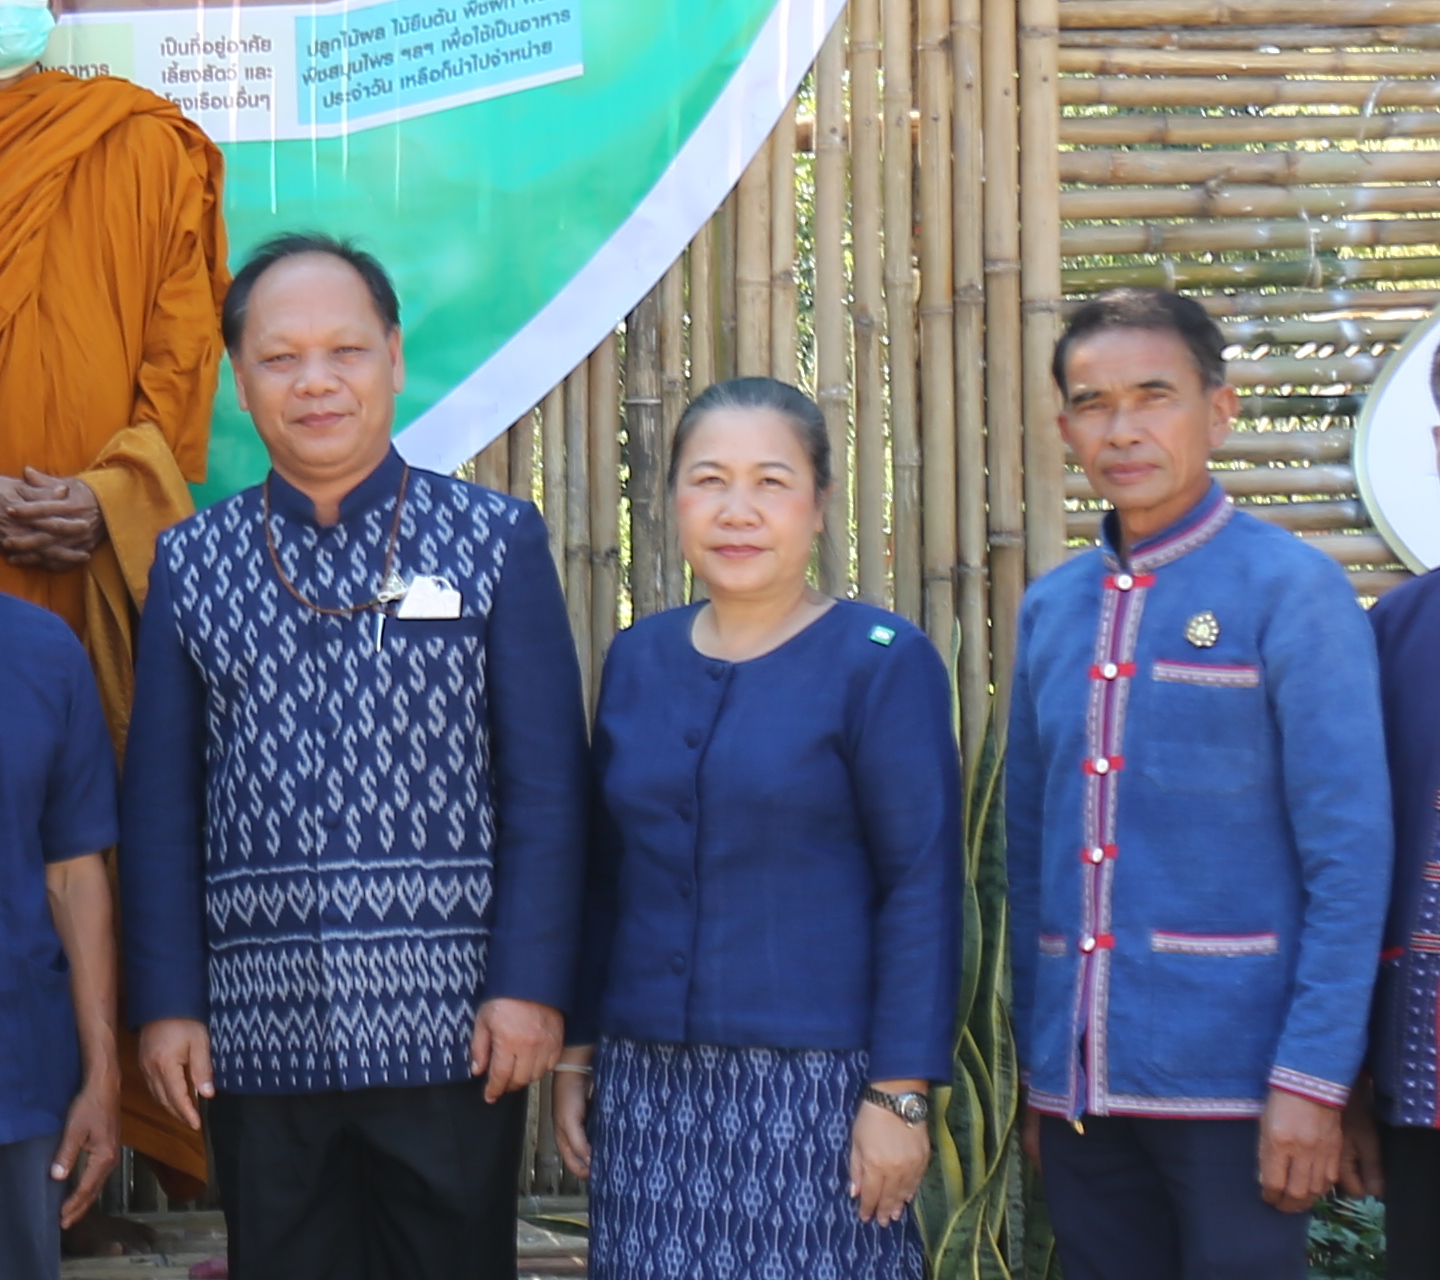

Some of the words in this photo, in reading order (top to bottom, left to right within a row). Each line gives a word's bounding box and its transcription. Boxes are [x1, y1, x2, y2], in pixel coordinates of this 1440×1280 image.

[160, 32, 272, 59] เป็นที่อยู่อาศัย
[302, 52, 395, 87] พืชสมุนไพร
[441, 8, 572, 53] เพื่อใช้เป็นอาหาร
[307, 26, 386, 60] ปลูกไม้ผล
[390, 7, 457, 37] ไม้ยืนต้น
[162, 60, 238, 84] เลี้ยงสัตว์
[244, 66, 273, 81] และ
[323, 77, 394, 109] ประจำวัน
